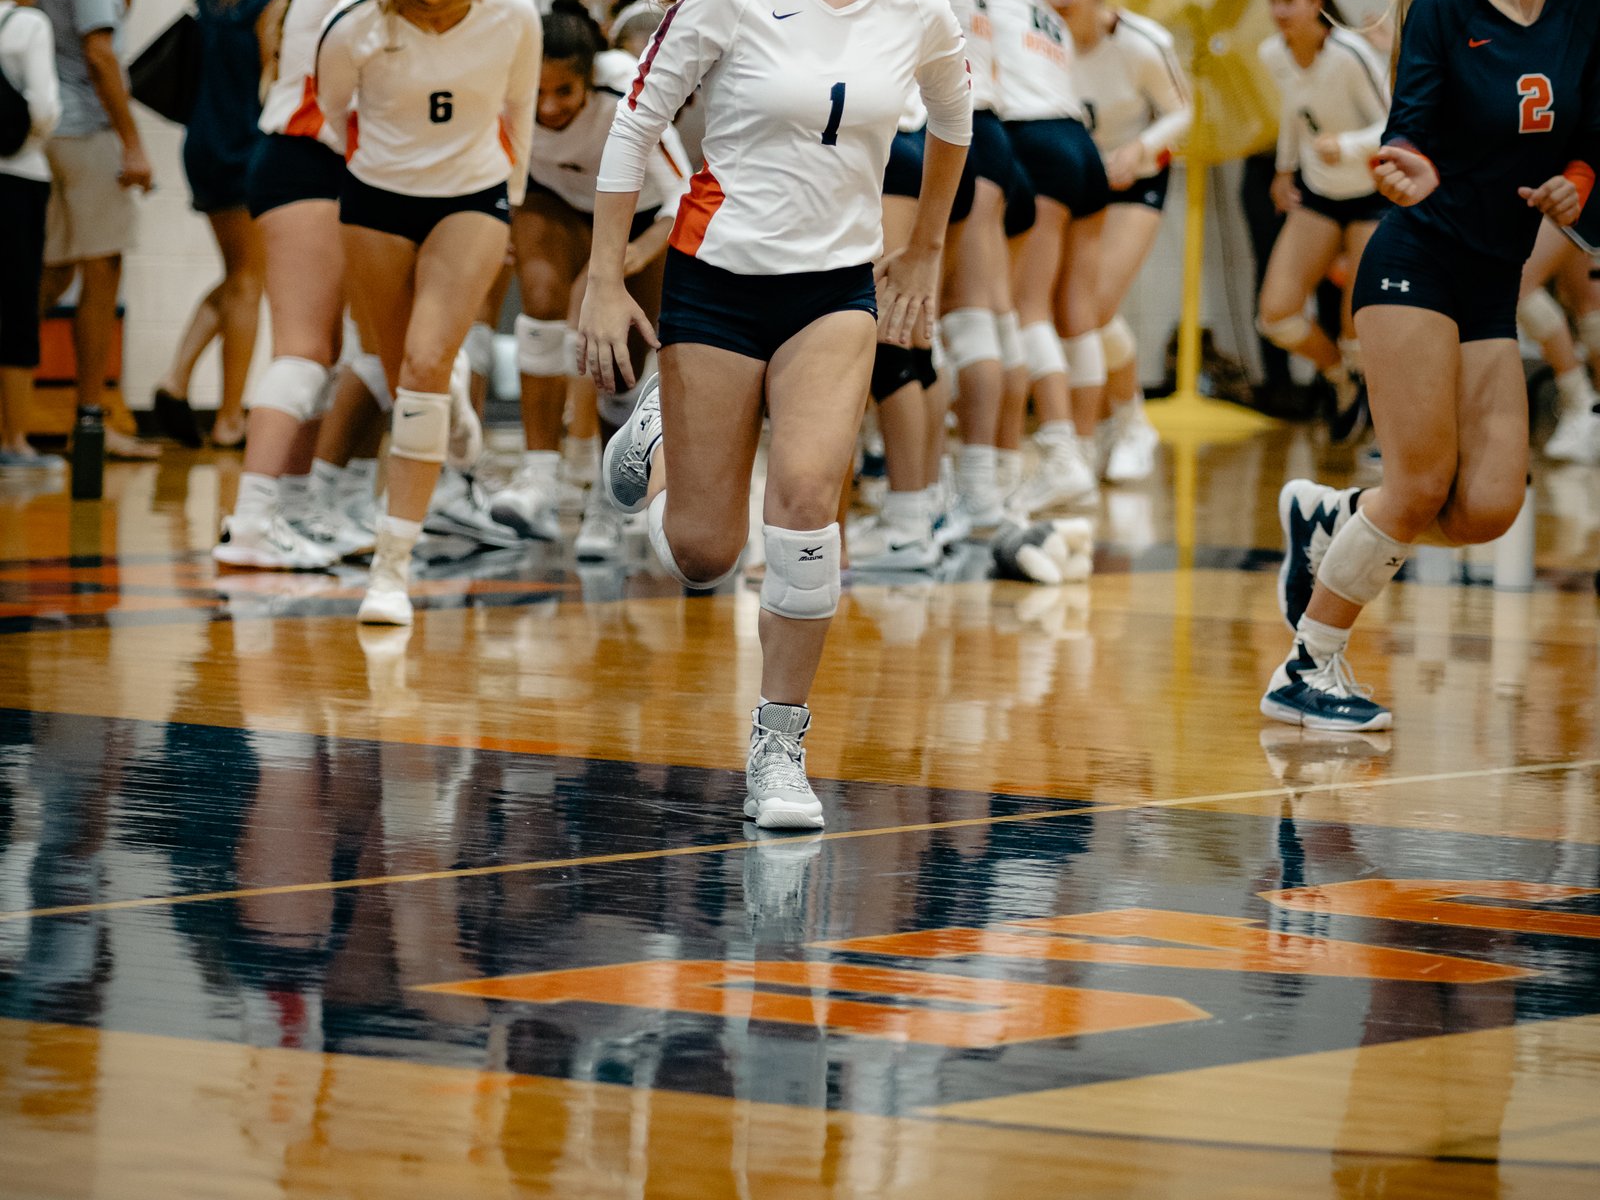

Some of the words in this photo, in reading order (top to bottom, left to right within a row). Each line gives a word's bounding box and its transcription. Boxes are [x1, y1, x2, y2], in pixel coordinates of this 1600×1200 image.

[430, 91, 453, 123] 6
[821, 82, 846, 146] 1
[1516, 73, 1555, 134] 2
